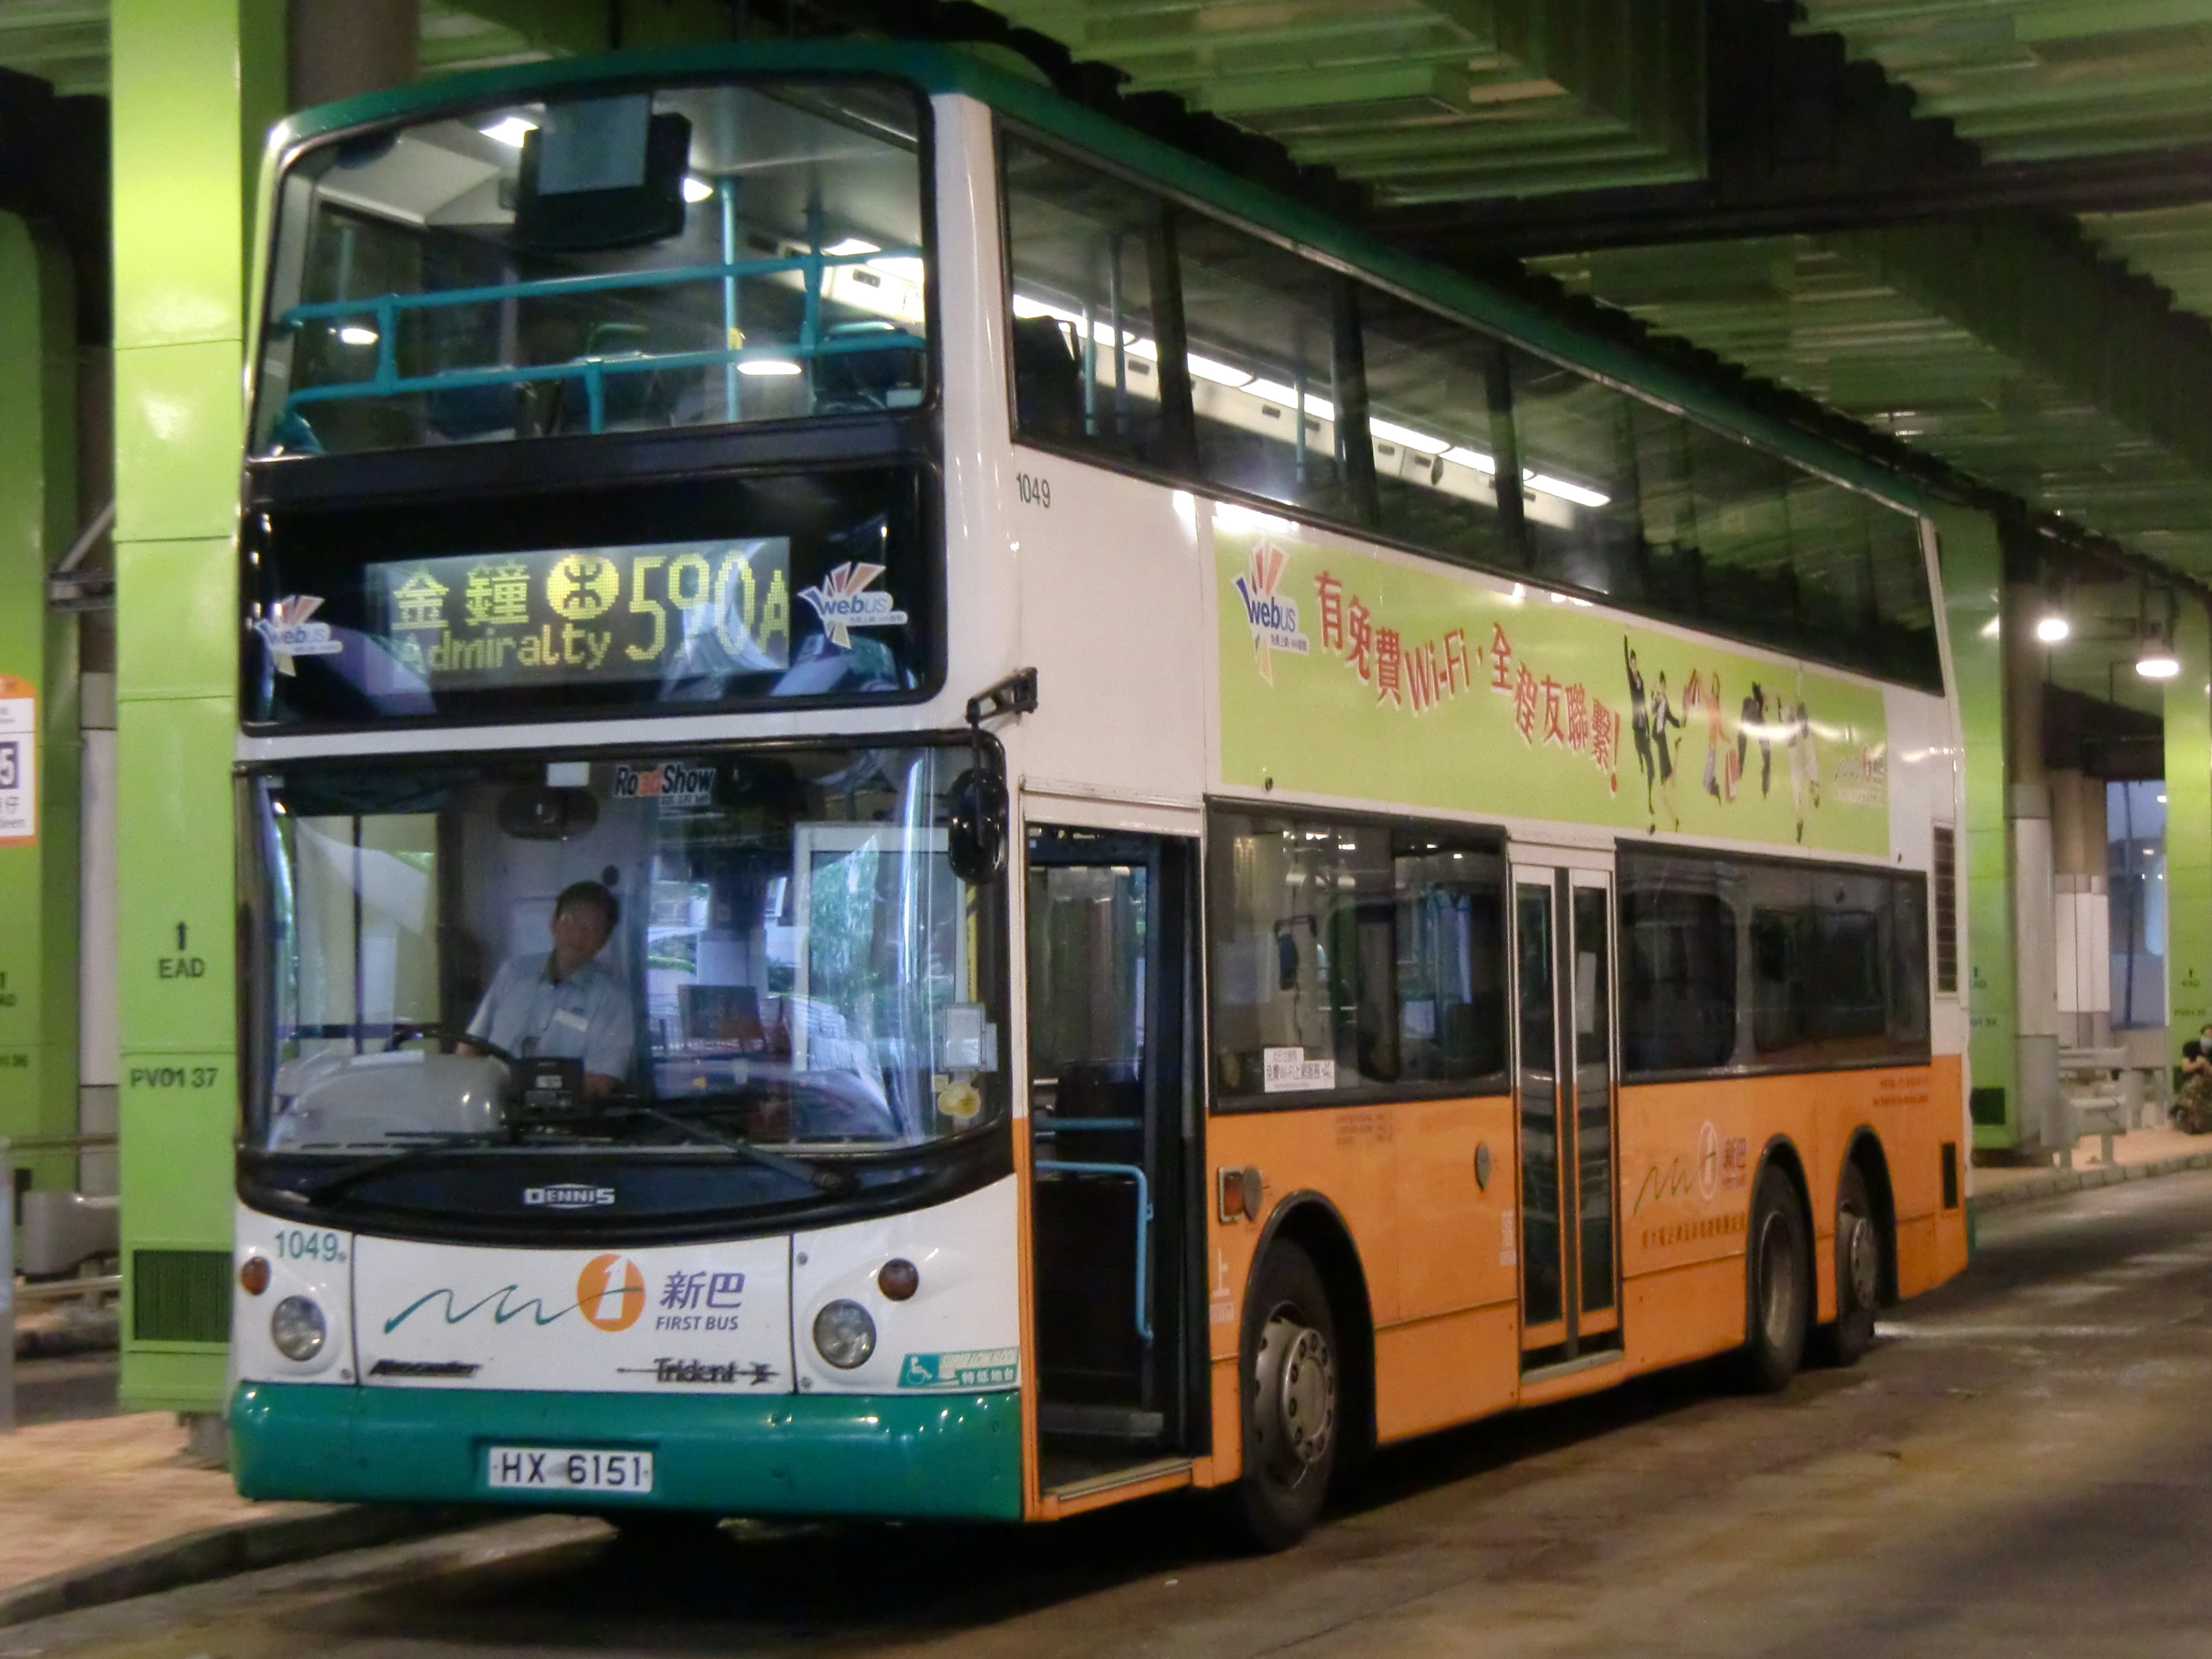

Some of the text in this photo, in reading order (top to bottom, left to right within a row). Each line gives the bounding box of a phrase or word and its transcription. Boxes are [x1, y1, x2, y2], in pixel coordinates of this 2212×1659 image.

[1016, 472, 1051, 509] 1049
[392, 563, 531, 631] 金鐘
[625, 551, 790, 661] 590A
[818, 594, 888, 615] webus
[1248, 596, 1296, 633] webus
[400, 624, 612, 675] Admiralty
[159, 958, 206, 978] EAD
[191, 1067, 219, 1088] 37
[524, 1187, 615, 1205] DENNIS
[275, 1230, 339, 1261] 1049
[659, 1270, 746, 1310] 新巴
[655, 1316, 739, 1331] FIRST BUS
[502, 1452, 640, 1486] HX 6151
